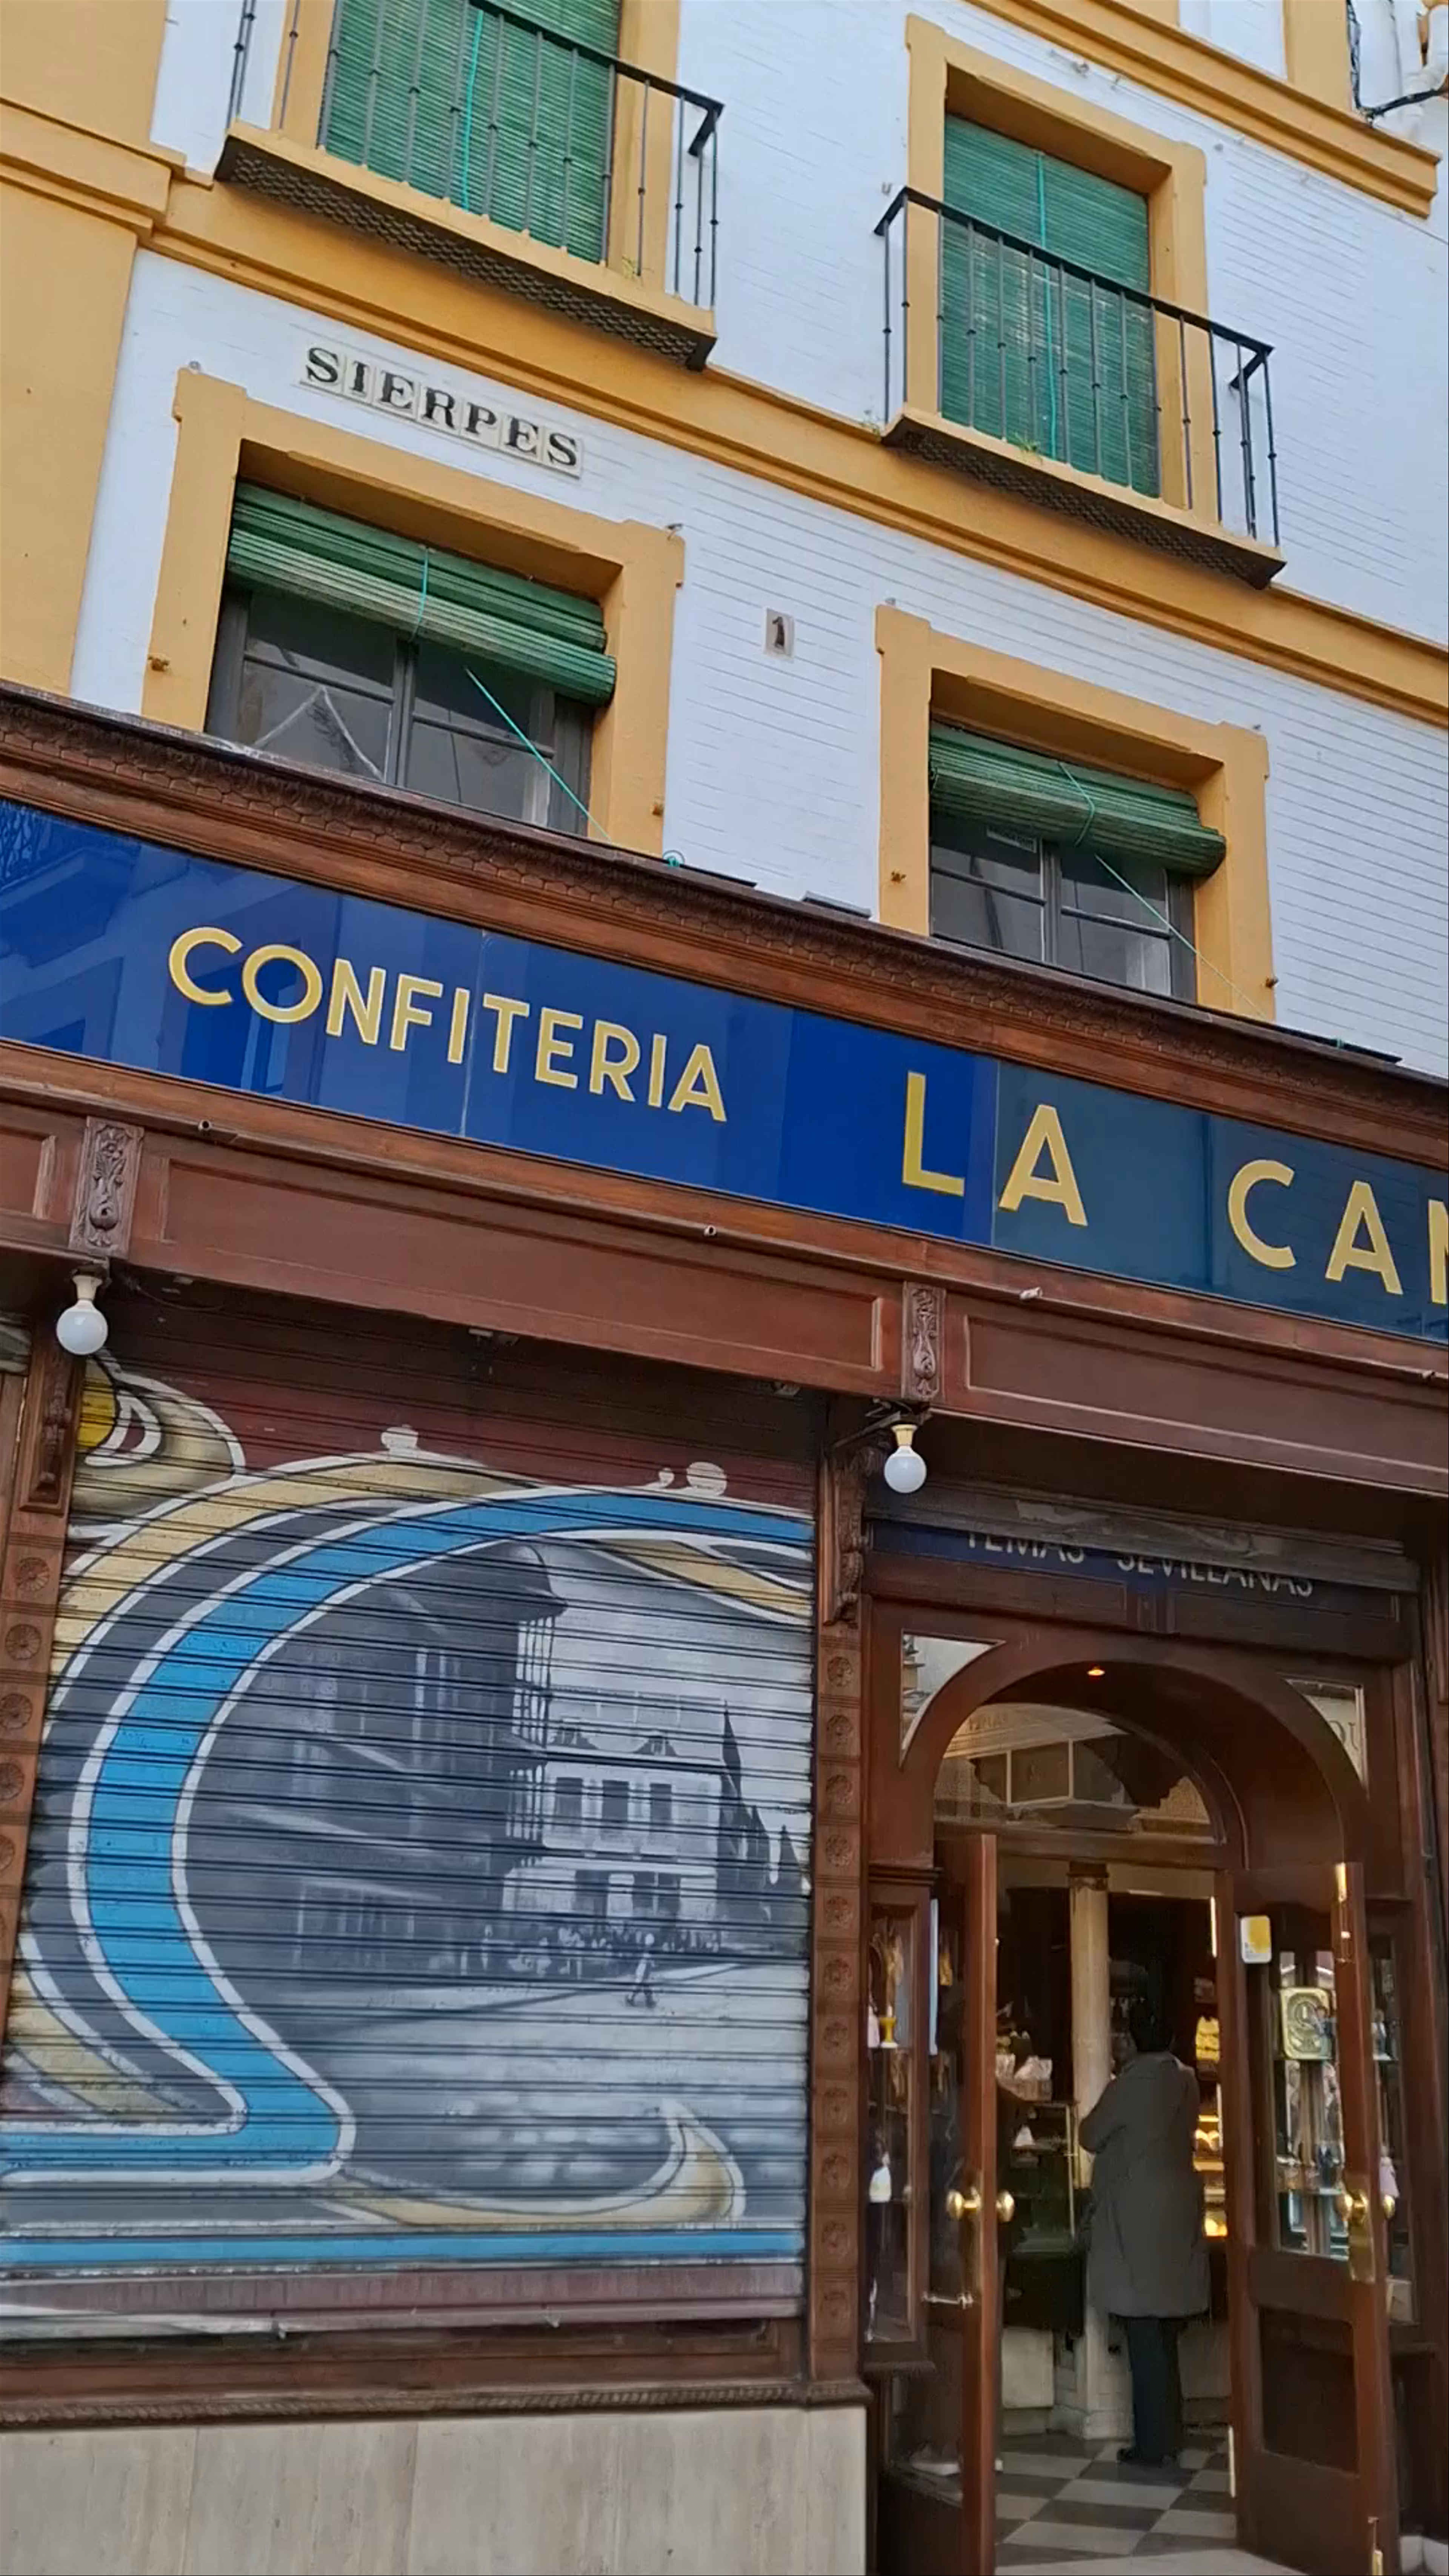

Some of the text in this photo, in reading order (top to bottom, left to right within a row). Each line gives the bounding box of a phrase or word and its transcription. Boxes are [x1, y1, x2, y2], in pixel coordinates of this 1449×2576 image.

[306, 347, 578, 466] SIERPES
[772, 616, 785, 648] 1
[169, 926, 1449, 1304] CONFITERIA LA CA
